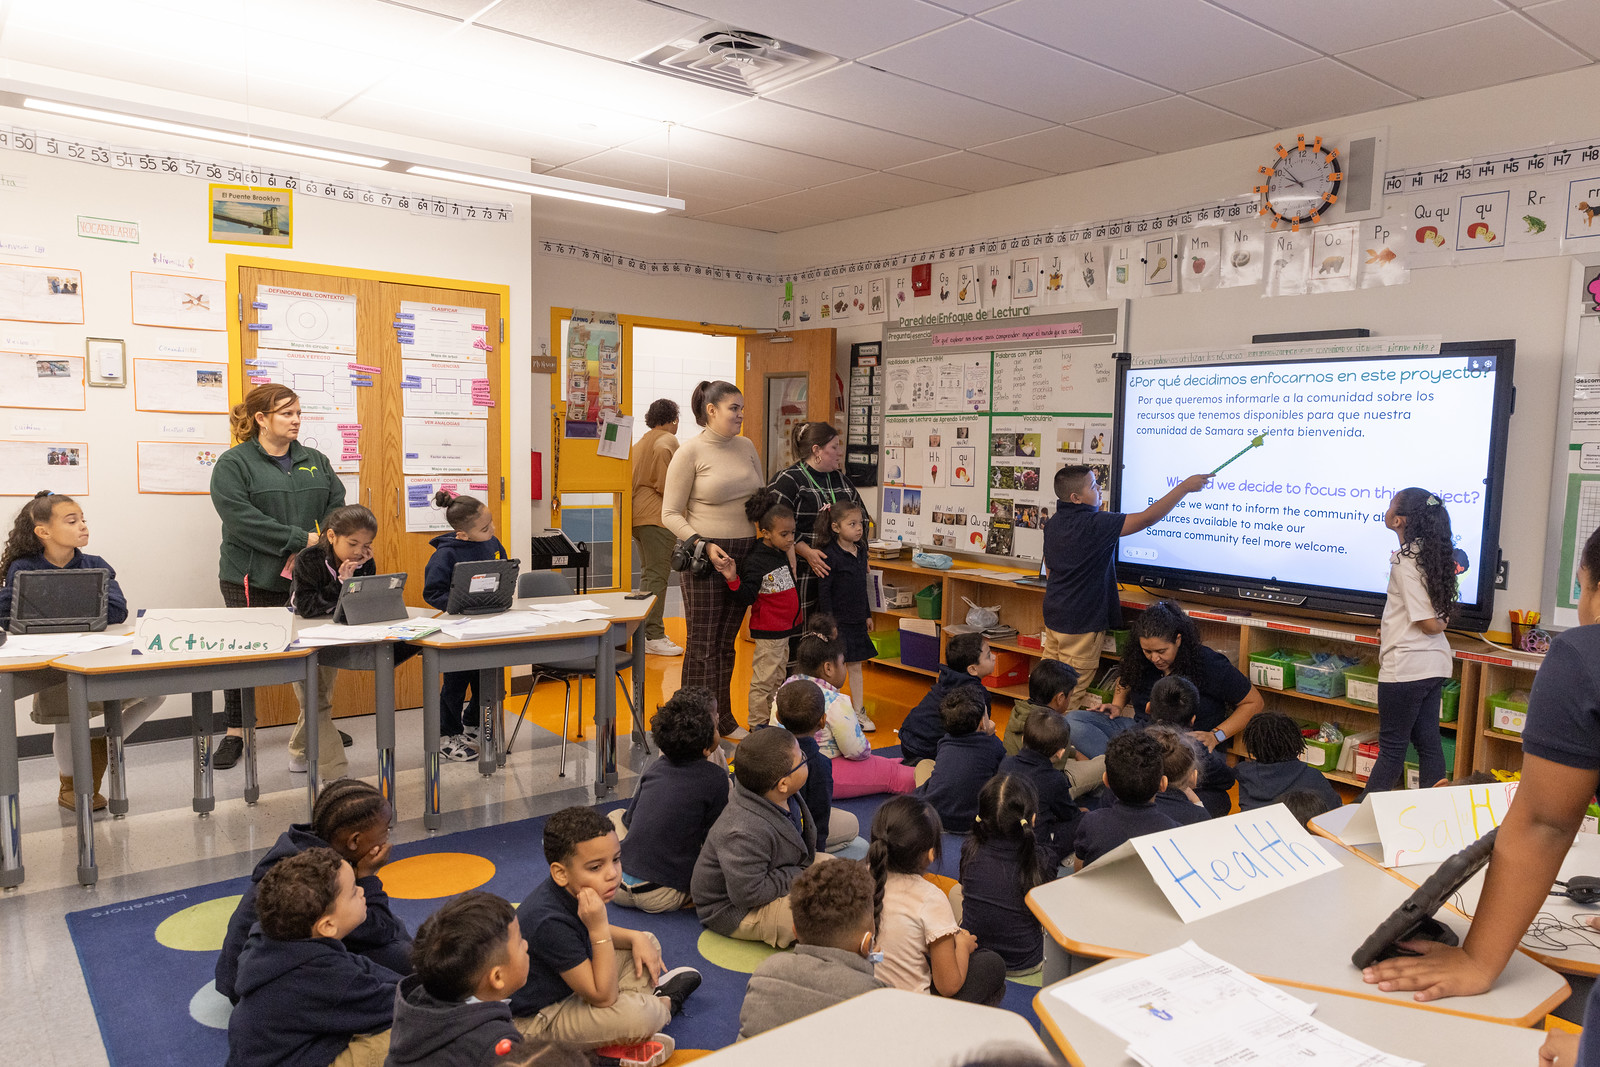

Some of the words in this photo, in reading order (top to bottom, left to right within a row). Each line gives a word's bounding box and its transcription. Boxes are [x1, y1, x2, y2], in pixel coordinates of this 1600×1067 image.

[1299, 150, 1307, 158] 12
[15, 136, 34, 150] 50
[47, 141, 59, 154] 51
[68, 145, 85, 159] 52
[91, 149, 109, 163] 53
[116, 155, 133, 167] 54
[139, 157, 157, 170] 55
[161, 160, 178, 172] 56
[185, 162, 201, 175] 57
[206, 166, 222, 179] 58
[227, 170, 242, 182] 59
[268, 177, 277, 186] 61
[285, 180, 297, 189] 62
[381, 196, 392, 206] 67
[398, 199, 409, 209] 68
[417, 202, 428, 211] 69
[434, 204, 445, 214] 70
[451, 206, 459, 216] 71
[466, 208, 476, 218] 72
[482, 210, 492, 220] 73
[497, 211, 508, 221] 74
[1274, 169, 1283, 178] 10
[1386, 179, 1402, 190] 140
[1412, 176, 1423, 187] 141
[1434, 173, 1448, 183] 142
[1456, 169, 1471, 180] 143
[1478, 165, 1494, 177] 144
[1503, 161, 1519, 173] 145
[1528, 158, 1544, 170] 146
[1553, 154, 1571, 166] 147
[1582, 150, 1599, 162] 148
[1271, 184, 1277, 192] 9
[252, 195, 281, 203] Brooklyn
[1213, 208, 1225, 218] 137
[1228, 206, 1240, 216] 138
[1246, 203, 1258, 214] 139
[1414, 205, 1432, 219] Qu
[1435, 206, 1450, 222] qu
[1475, 203, 1493, 220] qu
[79, 221, 137, 239] VOCABULARIO
[314, 293, 345, 301] CONTEXTO
[900, 316, 923, 327] Pared
[926, 315, 937, 324] de
[939, 311, 973, 326] Enfoque
[975, 309, 988, 320] de
[992, 306, 1030, 319] Lectura
[888, 332, 911, 341] Pregunta
[911, 331, 932, 340] esencial
[1129, 376, 1155, 388] ¿Por
[1158, 375, 1181, 389] qué
[1183, 373, 1247, 386] decidimos
[1250, 371, 1334, 385] enfocarnos
[1337, 372, 1357, 383] en
[1360, 369, 1396, 382] este
[1399, 365, 1491, 384] proyecto?
[1138, 395, 1153, 405] Por
[1155, 397, 1173, 407] que
[1175, 396, 1223, 407] queremos
[1225, 392, 1280, 404] informarle
[1283, 395, 1290, 403] a
[1293, 392, 1303, 403] la
[1306, 391, 1373, 403] comunidad
[1377, 390, 1413, 402] sobre
[1416, 390, 1434, 401] los
[939, 416, 958, 424] Aprendo
[1137, 411, 1175, 420] recursos
[1177, 412, 1195, 422] que
[1198, 410, 1241, 420] tenemos
[1243, 409, 1304, 422] disponibles
[1307, 411, 1334, 422] para
[1337, 411, 1360, 422] que
[1363, 409, 1411, 420] nuestra
[1136, 425, 1187, 435] comunidad
[1189, 425, 1202, 435] de
[1205, 426, 1244, 436] Samara
[1246, 428, 1259, 437] se
[1261, 426, 1294, 437] sienta
[1297, 426, 1366, 438] bienvenida.
[1216, 482, 1236, 491] we
[1238, 479, 1283, 493] decide
[1286, 483, 1301, 494] to
[1304, 482, 1346, 497] focus
[1350, 488, 1371, 499] on
[1375, 486, 1400, 500] thi
[1188, 501, 1202, 509] we
[1204, 502, 1229, 511] want
[1232, 502, 1243, 512] to
[1245, 502, 1280, 515] inform
[1283, 506, 1301, 517] the
[1303, 508, 1369, 524] community
[1193, 516, 1238, 528] available
[1240, 519, 1251, 529] to
[1254, 520, 1283, 532] make
[1286, 524, 1305, 534] our
[1146, 527, 1182, 538] Samara
[1184, 531, 1239, 546] community
[1242, 534, 1261, 546] feel
[1263, 539, 1292, 550] more
[1295, 541, 1348, 555] welcome.
[1152, 820, 1326, 908] Health
[91, 893, 187, 918] Lakeshore
